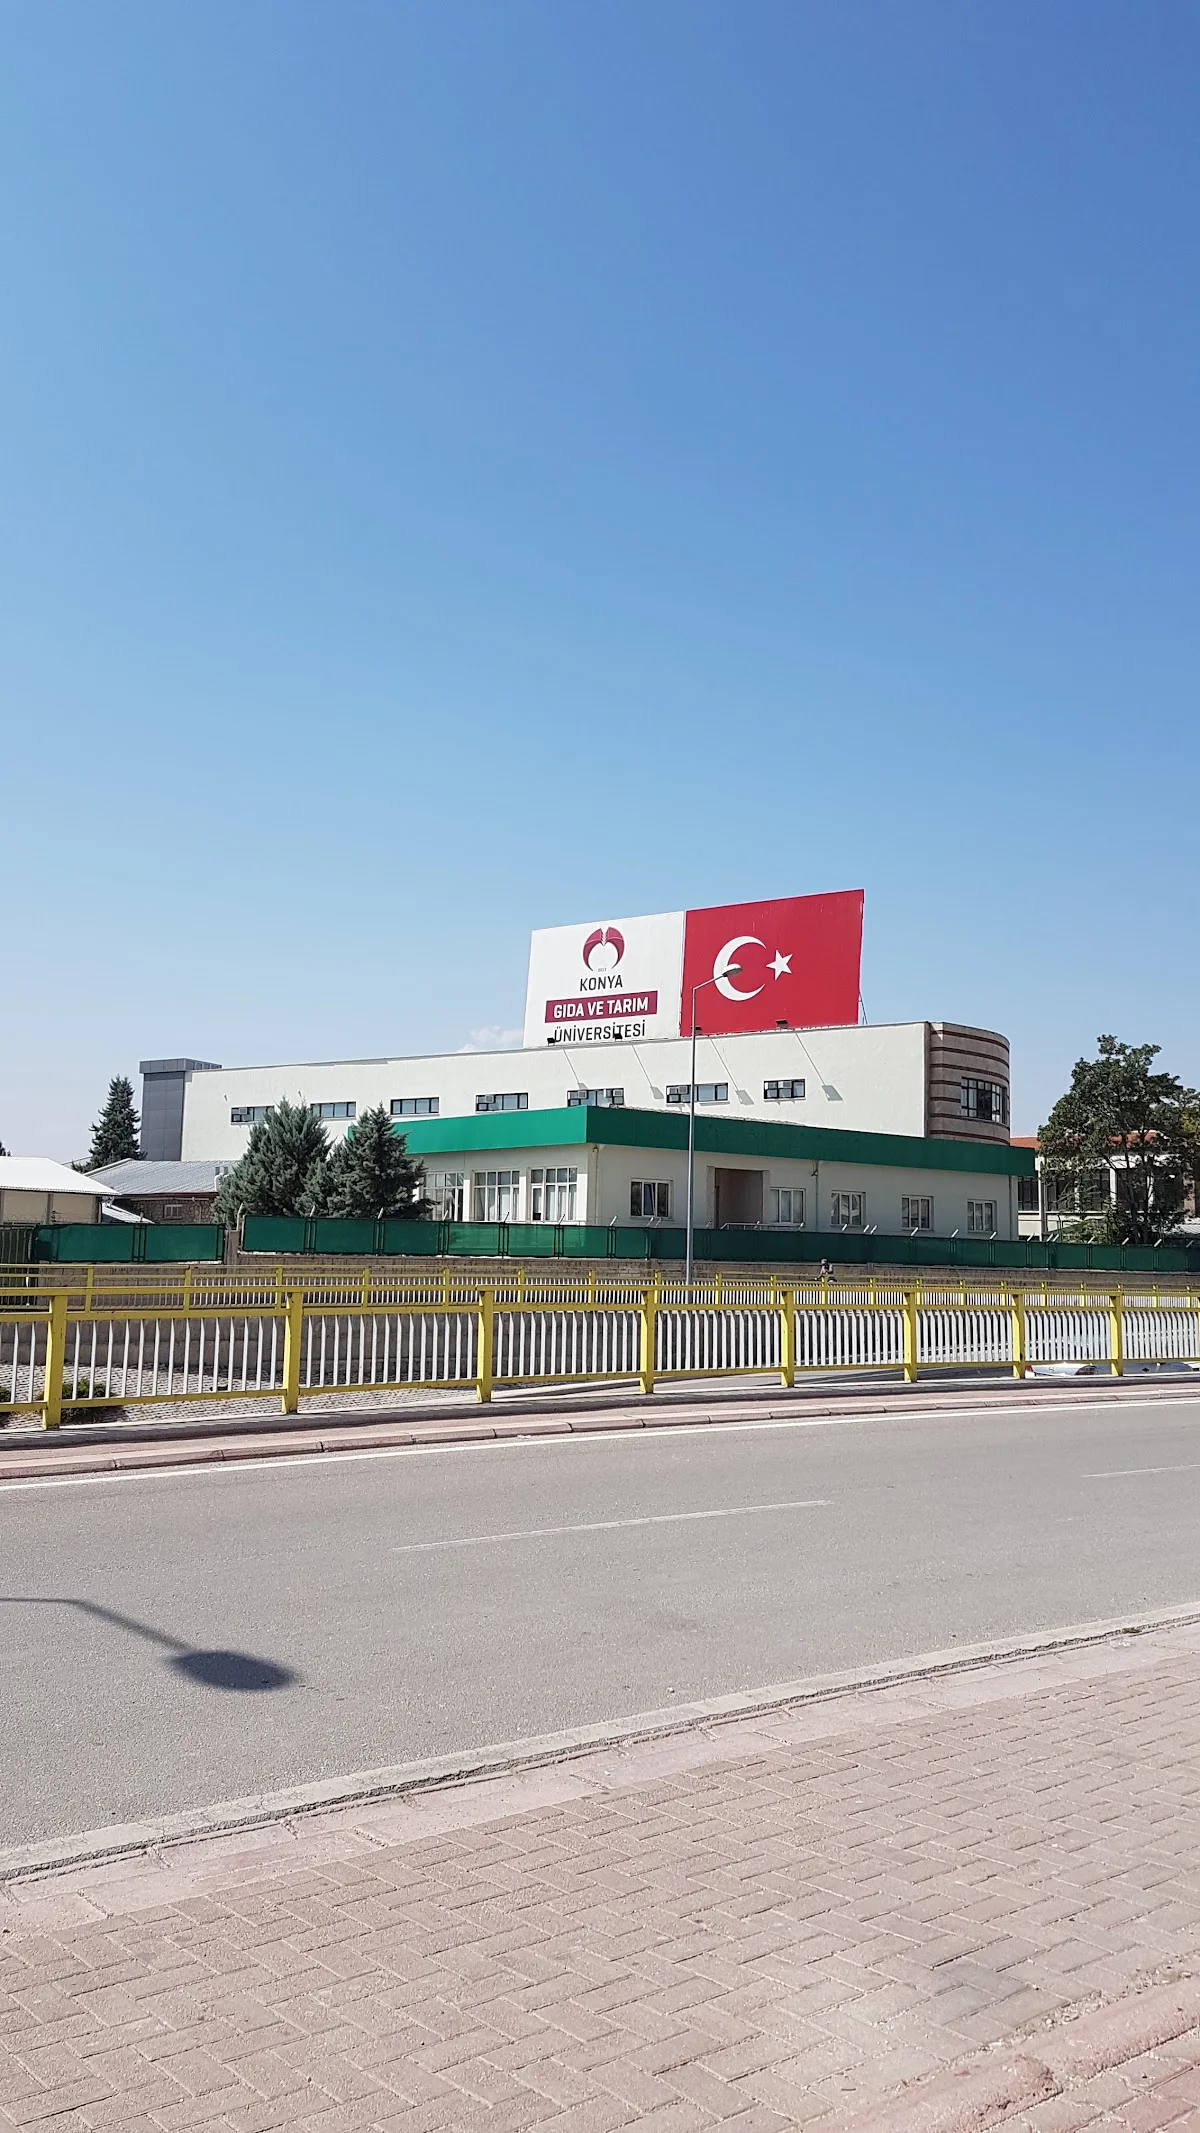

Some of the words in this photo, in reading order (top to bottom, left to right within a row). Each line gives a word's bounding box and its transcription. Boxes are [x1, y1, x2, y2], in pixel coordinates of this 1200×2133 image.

[579, 974, 623, 992] KONYA
[553, 1003, 585, 1019] GIDA
[587, 1001, 604, 1016] VE
[606, 997, 649, 1014] TARIM
[554, 1019, 646, 1043] ÜNİVERSİTESİ
